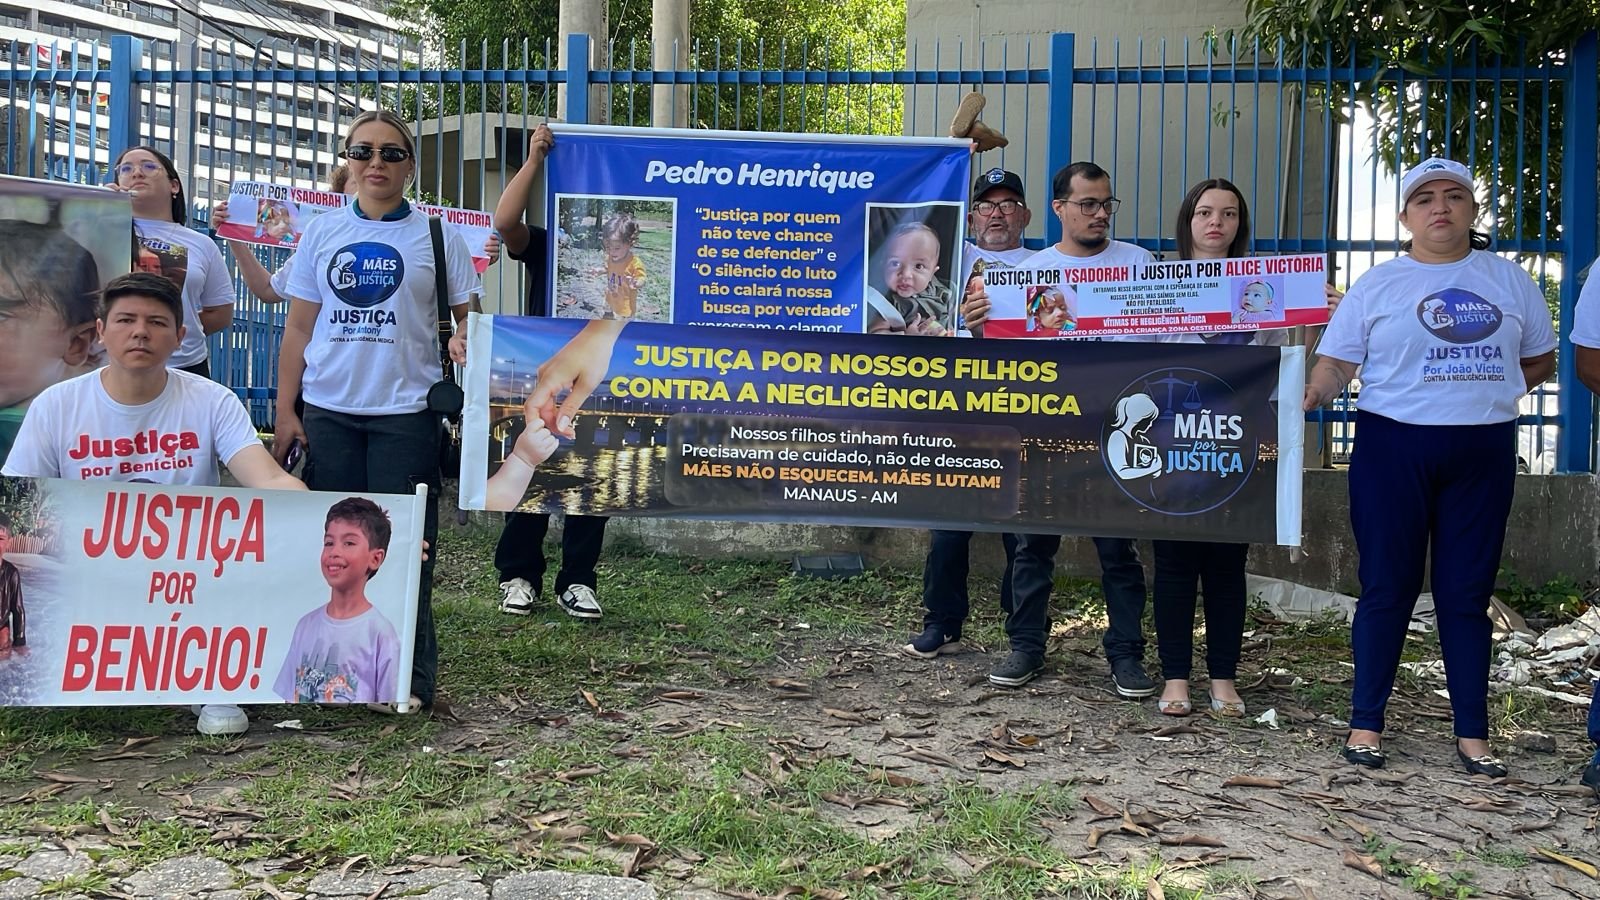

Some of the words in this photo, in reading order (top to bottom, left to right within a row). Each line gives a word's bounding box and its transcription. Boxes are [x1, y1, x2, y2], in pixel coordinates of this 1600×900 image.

[646, 160, 734, 185] Pedro
[736, 162, 874, 194] Henrique
[268, 186, 288, 200] POR
[290, 188, 341, 208] YSADORAH
[417, 206, 443, 217] ICE
[446, 210, 491, 228] VICTORIA
[763, 212, 790, 225] por
[794, 212, 840, 226] quem
[702, 226, 732, 239] não
[736, 228, 771, 240] teve
[774, 228, 833, 242] chance
[697, 245, 718, 258] de
[721, 248, 740, 258] se
[827, 251, 837, 261] e
[362, 257, 397, 270] MÃES
[715, 263, 777, 278] silêncio
[781, 266, 801, 279] do
[806, 266, 837, 280] luto
[358, 275, 395, 287] JUSTIÇA
[984, 270, 1032, 289] JUSTIÇA
[1037, 270, 1060, 284] POR
[1064, 266, 1128, 284] YSADORAH
[1141, 264, 1192, 283] JUSTIÇA
[1197, 262, 1222, 277] POR
[1226, 260, 1261, 276] ALICE
[1266, 257, 1324, 274] VICTORIA
[700, 282, 730, 295] não
[734, 283, 782, 296] calará
[787, 287, 832, 298] nossa
[703, 301, 750, 314] busca
[755, 305, 782, 318] por
[1130, 307, 1162, 315] NEGLIGÊNCIA
[1455, 302, 1492, 311] MÃES
[330, 310, 397, 327] JUSTIÇA
[1104, 317, 1129, 327] VÍTIMAS
[1131, 318, 1139, 326] DE
[1140, 315, 1180, 326] NEGLIGÊNCIA
[1181, 314, 1206, 324] MÉDICA
[1455, 314, 1497, 324] JUSTIÇA
[1426, 346, 1502, 361] JUSTIÇA
[634, 345, 754, 375] JUSTIÇA
[762, 351, 823, 374] POR
[830, 354, 947, 378] NOSSOS
[954, 358, 1058, 382] FILHOS
[1424, 365, 1442, 375] Por
[1446, 364, 1472, 374] João
[1452, 373, 1486, 381] NEGLIGÊNCIA
[609, 376, 731, 402] CONTRA
[736, 382, 760, 403] A
[767, 382, 959, 411] NEGLIGÊNCIA
[966, 386, 1082, 416] MÉDICA
[1174, 409, 1243, 440] MÃES
[730, 426, 787, 441] Nossos
[791, 428, 836, 443] filhos
[840, 430, 898, 446] tinham
[902, 433, 956, 448] futuro.
[682, 443, 774, 460] Precisavam
[778, 448, 799, 461] de
[802, 448, 872, 466] cuidado,
[876, 452, 906, 466] não
[910, 453, 931, 466] de
[934, 454, 1004, 469] descaso.
[1192, 440, 1219, 455] por
[81, 465, 113, 480] por
[120, 455, 194, 474] Benício!
[1166, 451, 1243, 478] JUSTIÇA
[683, 460, 732, 477] MÃES
[736, 462, 775, 479] NÃO
[780, 467, 878, 484] ESQUECEM.
[882, 469, 932, 486] MÃES
[936, 474, 1001, 488] LUTAM!
[784, 486, 857, 502] MANAUS
[870, 491, 898, 504] AM
[83, 491, 264, 578] JUSTIÇA
[148, 571, 197, 604] POR
[62, 611, 268, 693] BENÍCIO!
